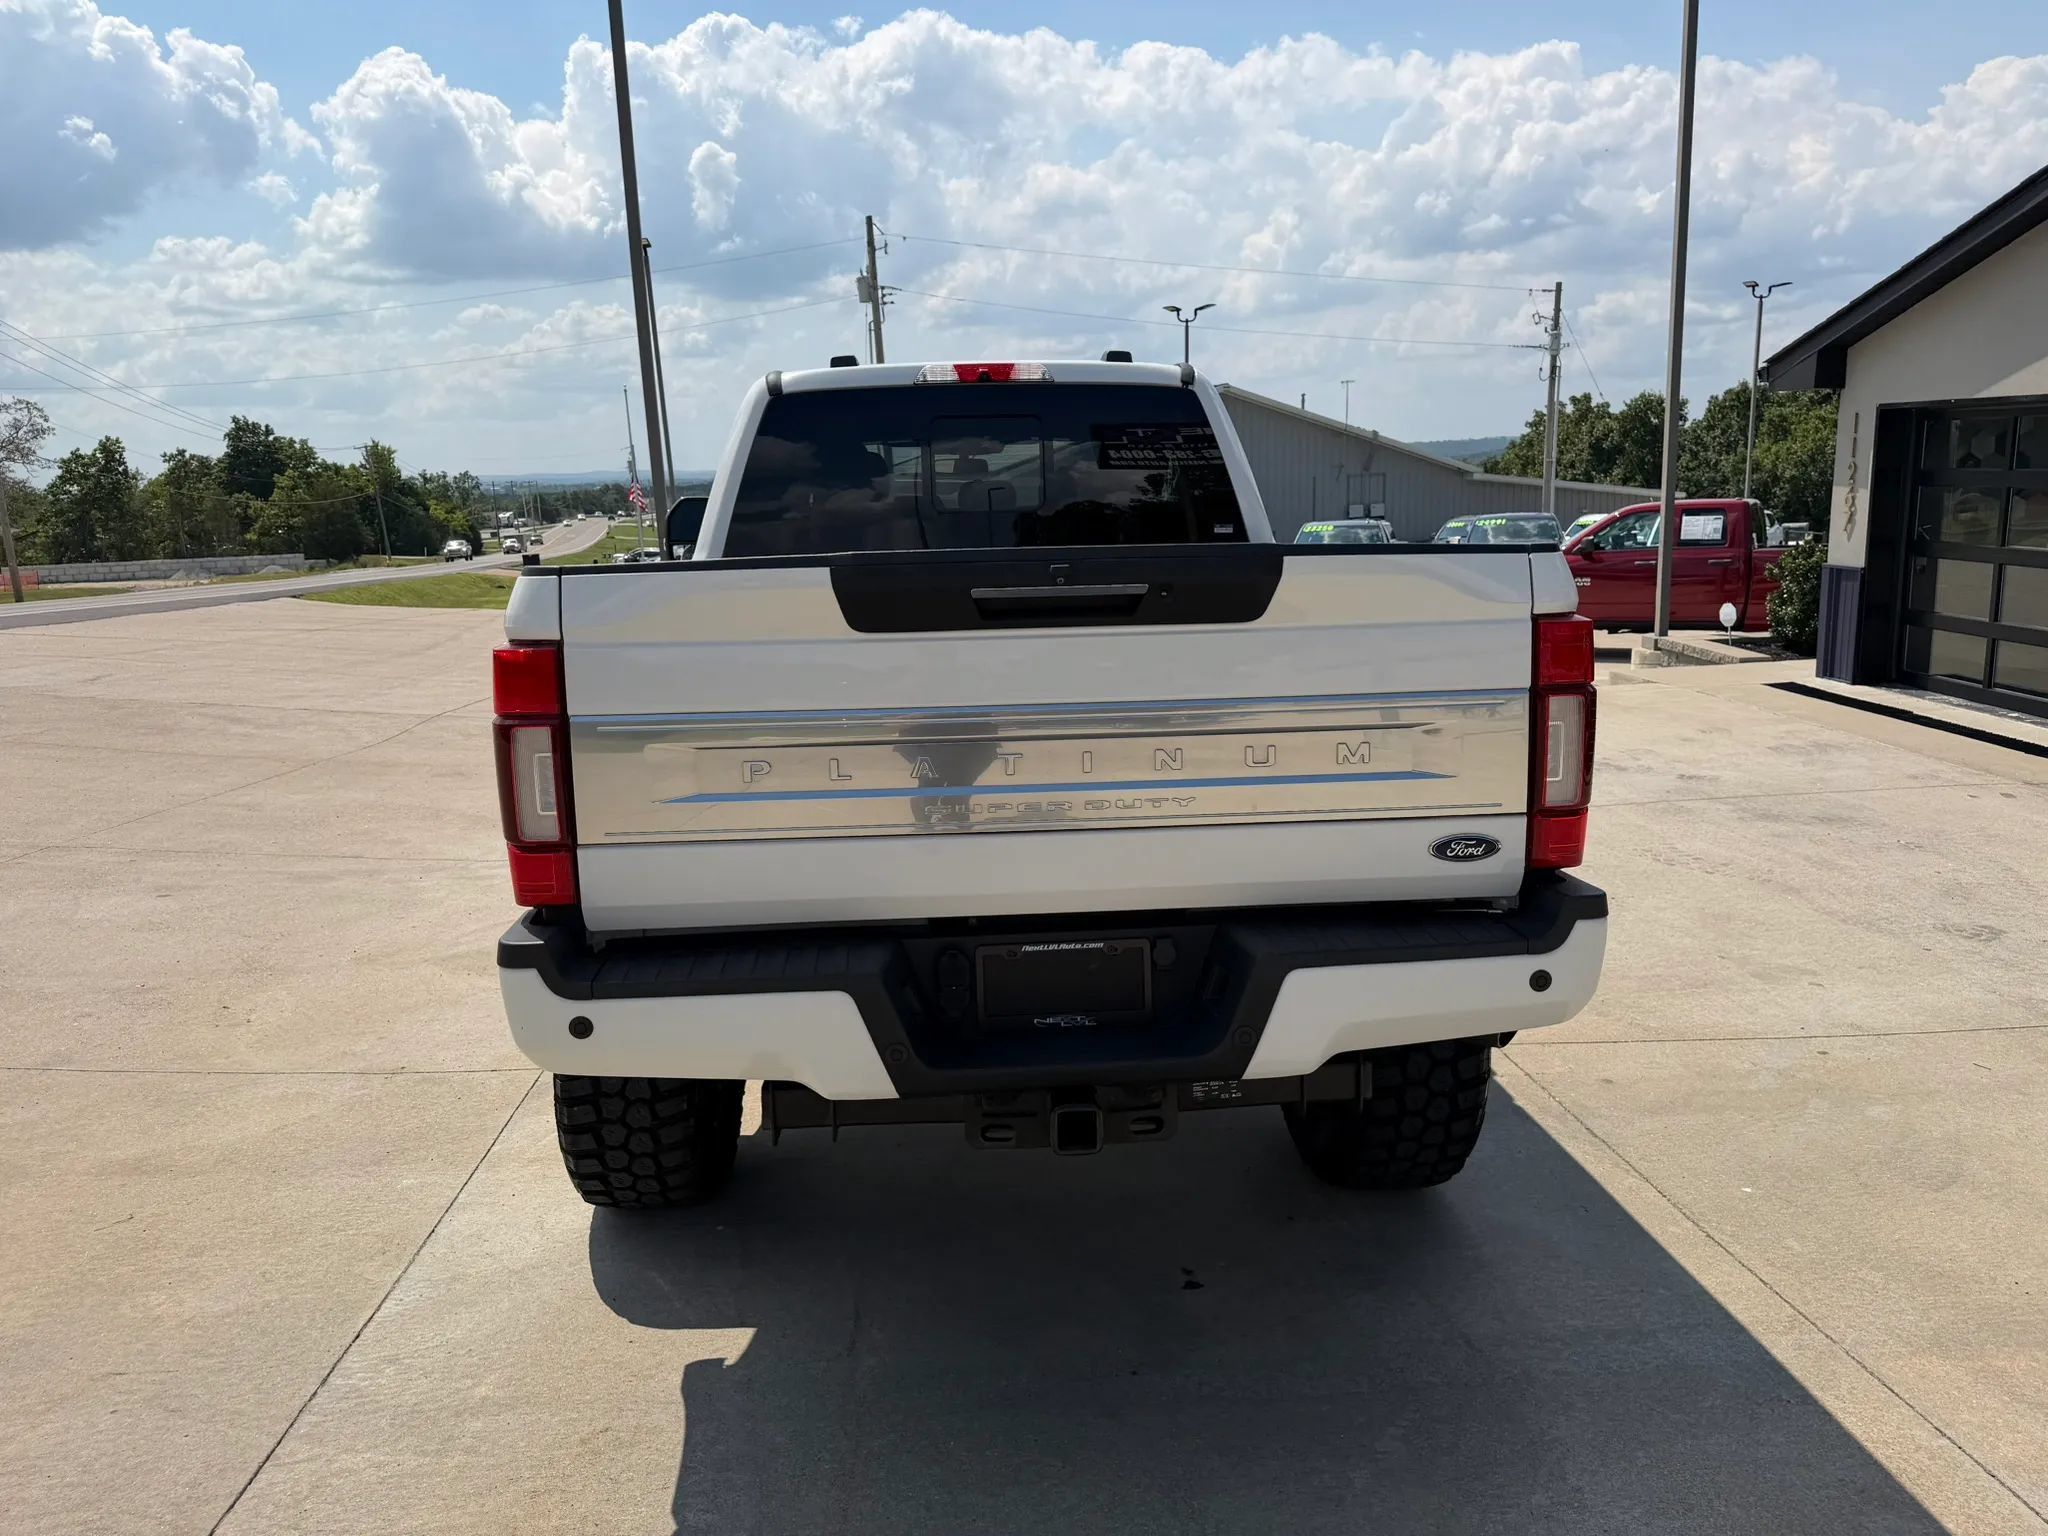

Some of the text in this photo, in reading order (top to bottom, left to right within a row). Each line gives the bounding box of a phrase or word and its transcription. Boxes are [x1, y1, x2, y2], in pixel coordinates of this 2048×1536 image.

[742, 740, 1373, 784] PLATINUM
[923, 797, 1198, 816] SUPER DUTY
[1446, 839, 1486, 857] Ford
